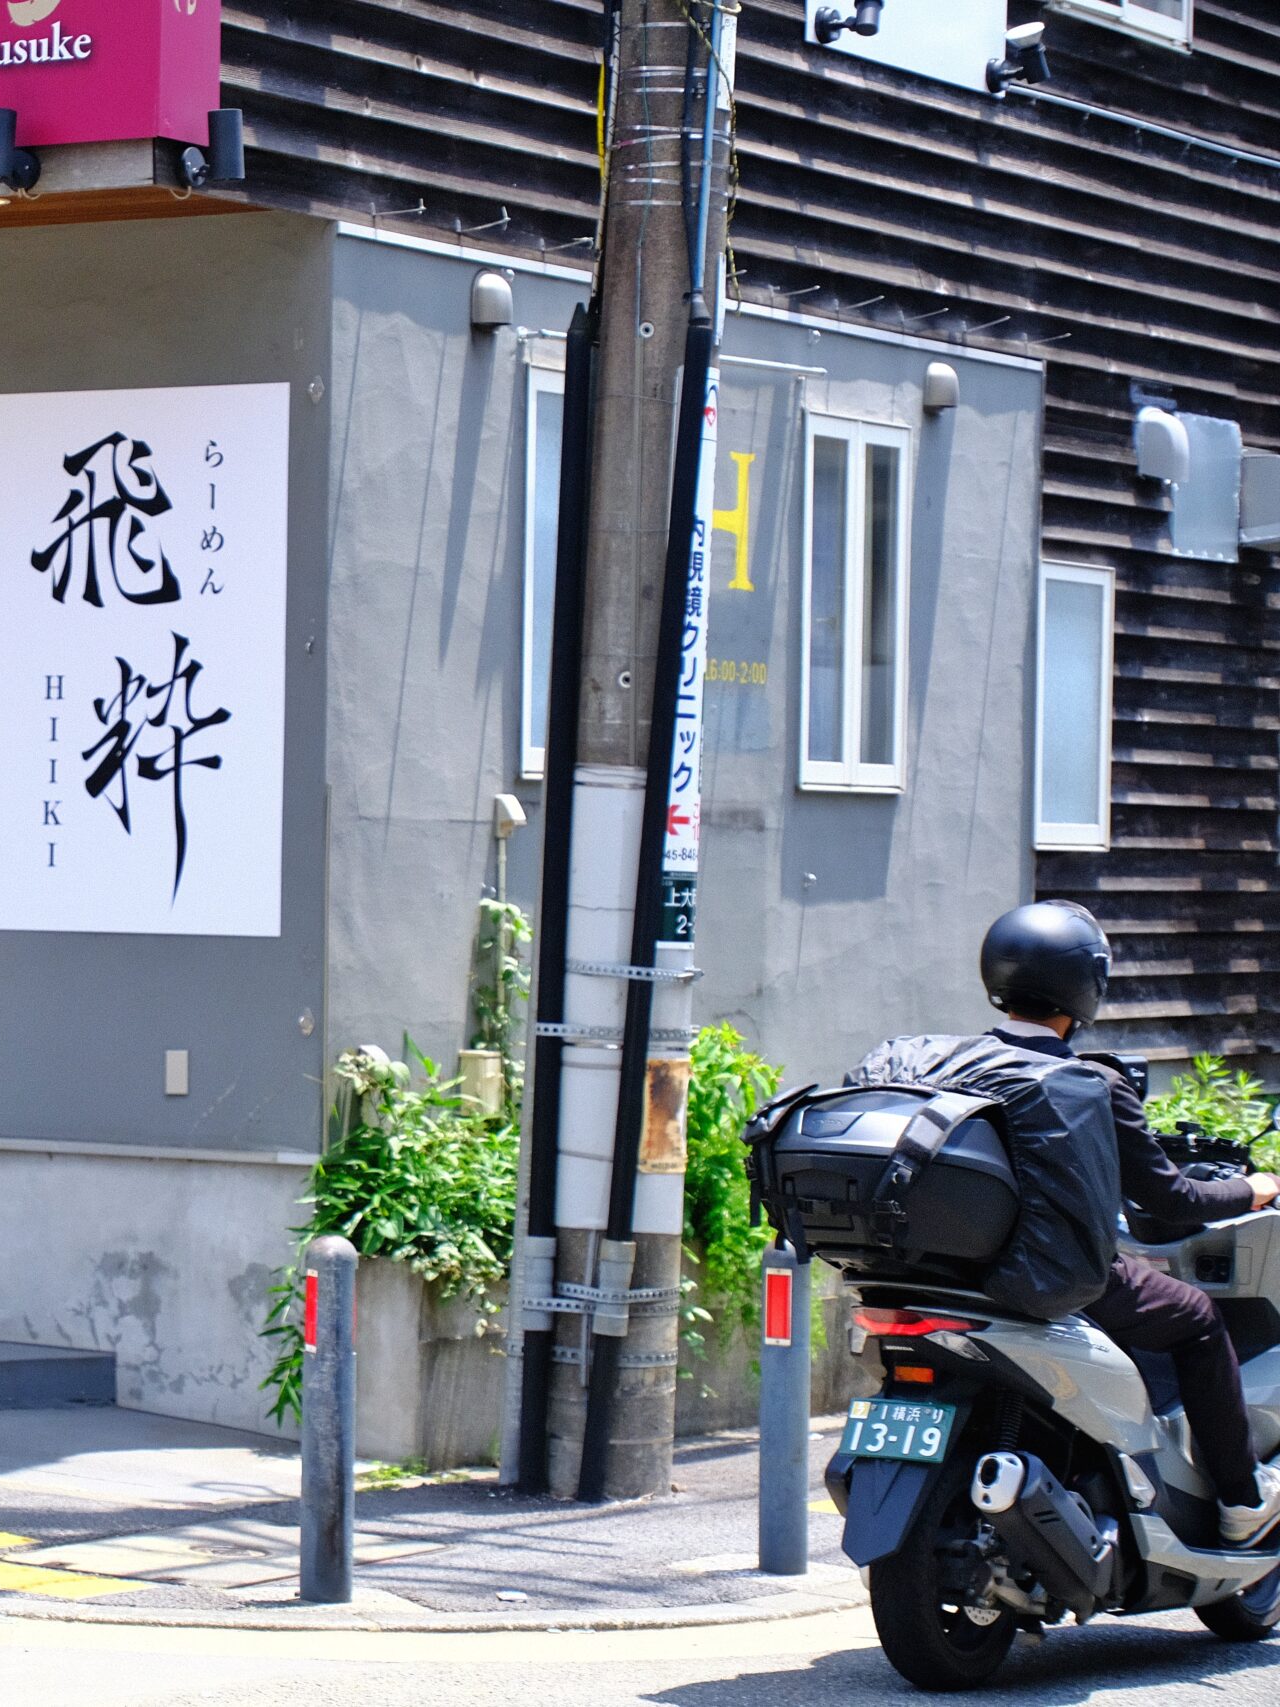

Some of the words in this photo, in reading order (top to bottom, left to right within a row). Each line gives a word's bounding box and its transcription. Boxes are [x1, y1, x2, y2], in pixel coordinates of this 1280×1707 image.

[200, 439, 225, 596] らーめん
[30, 431, 232, 911] 飛粋
[42, 674, 65, 868] HIIKI
[849, 1421, 942, 1457] 13-19
[892, 1406, 921, 1422] 横浜
[931, 1409, 944, 1424] り
